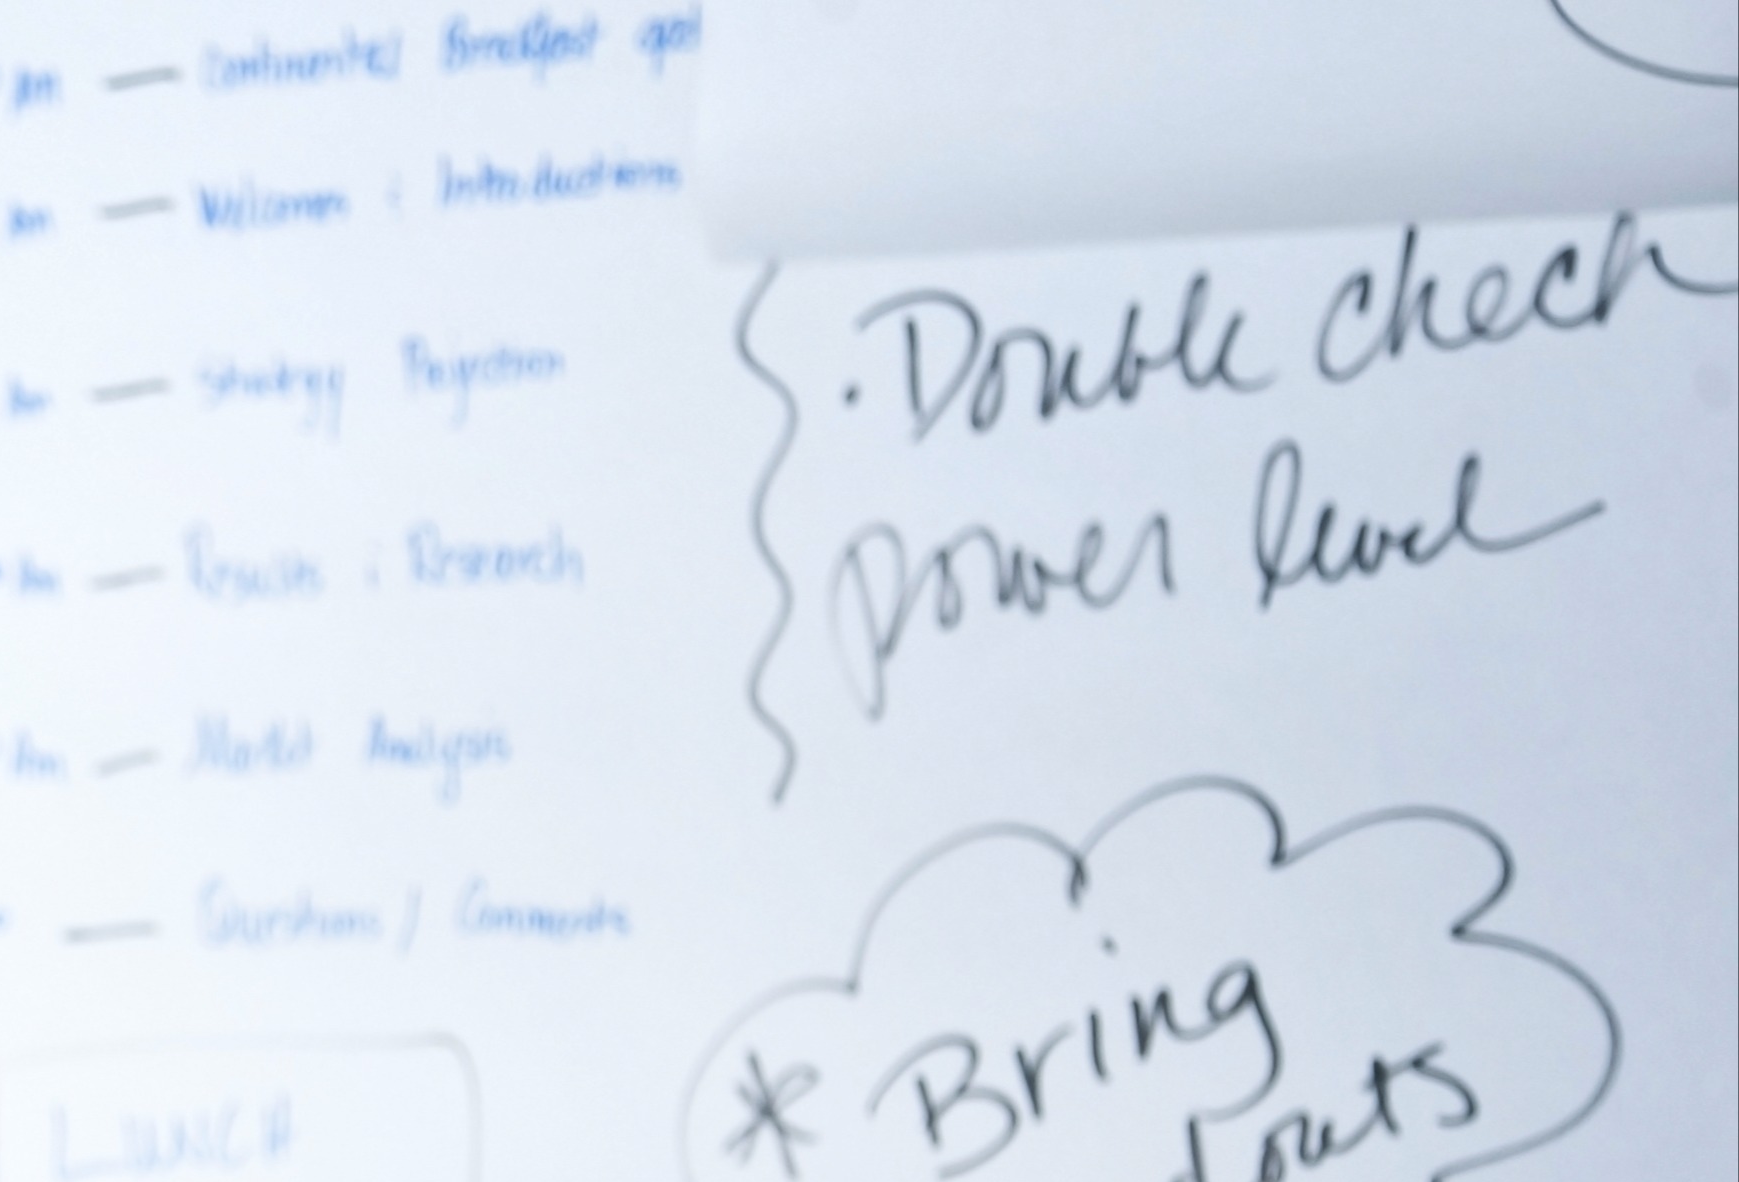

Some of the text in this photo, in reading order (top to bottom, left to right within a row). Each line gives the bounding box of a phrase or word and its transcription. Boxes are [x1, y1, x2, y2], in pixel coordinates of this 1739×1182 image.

[854, 208, 1739, 441] Double check
[828, 436, 1606, 725] power level
[47, 1091, 295, 1182] LUNCH
[867, 932, 1284, 1182] Bring
